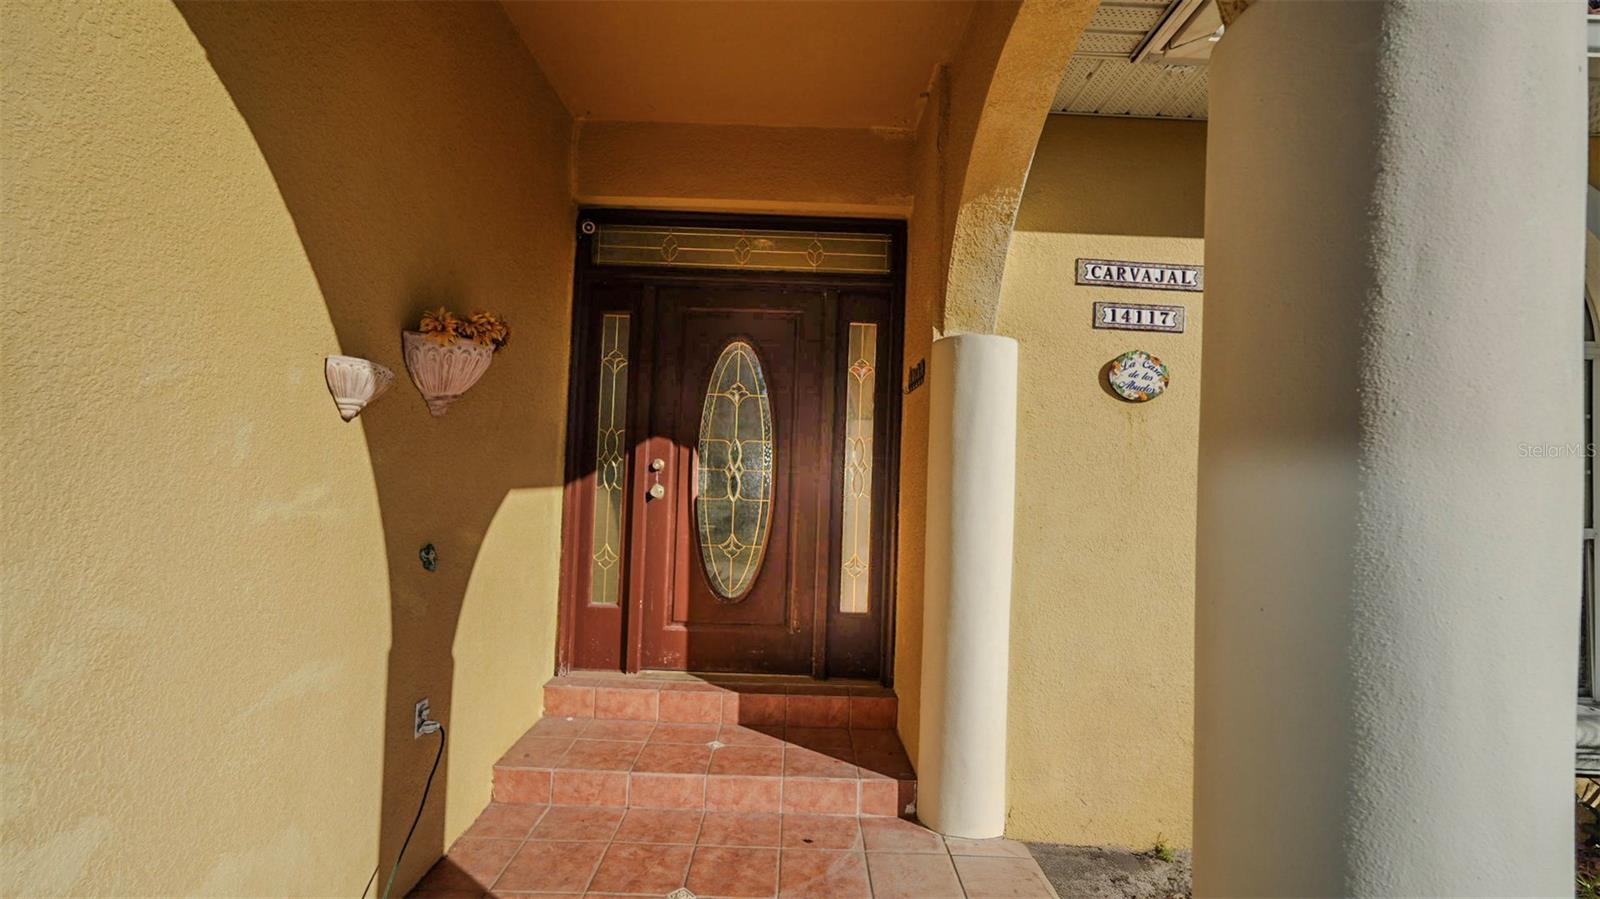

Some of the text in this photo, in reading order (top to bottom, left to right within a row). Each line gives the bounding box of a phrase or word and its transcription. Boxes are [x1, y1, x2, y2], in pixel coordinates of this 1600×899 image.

[1091, 265, 1192, 285] CARVAJAL
[1111, 309, 1169, 325] 14117
[1121, 361, 1136, 371] La
[1128, 370, 1153, 381] de los
